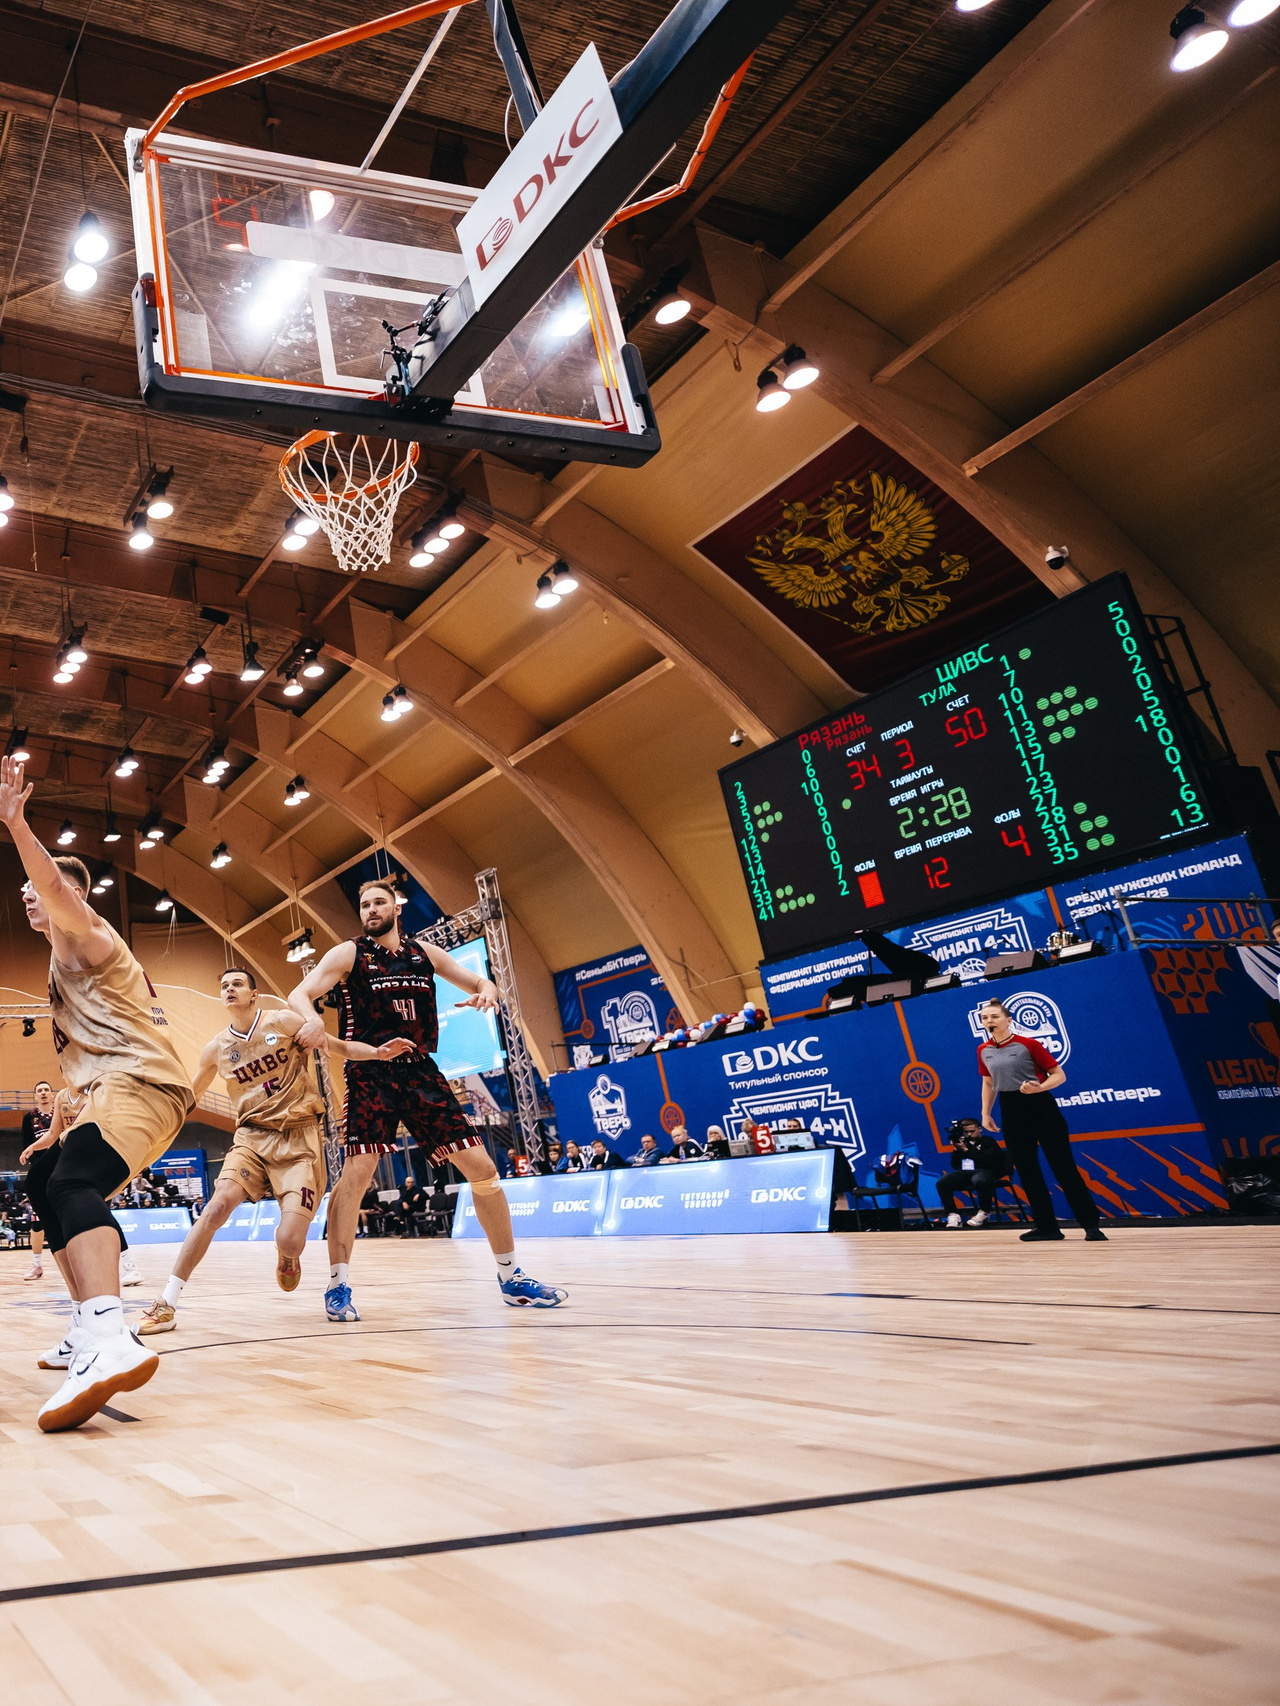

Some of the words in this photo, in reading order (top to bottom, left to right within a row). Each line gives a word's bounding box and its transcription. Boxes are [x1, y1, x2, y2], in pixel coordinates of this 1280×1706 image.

[513, 97, 600, 224] DKC
[1000, 655, 1010, 671] 1
[1107, 600, 1124, 621] 5
[1003, 669, 1015, 688] 7
[1115, 619, 1130, 637] 0
[936, 643, 993, 683] ЦИВС
[998, 687, 1024, 710] 10
[1122, 636, 1138, 655] 0
[919, 682, 957, 706] ТУЛА
[946, 694, 970, 712] СЧЕТ
[1004, 704, 1028, 726] 11
[1128, 654, 1146, 674] 2
[1010, 720, 1037, 743] 13
[1135, 672, 1152, 690] 0
[881, 720, 914, 742] ПЕРИОД
[945, 707, 988, 748] 50
[1016, 736, 1042, 759] 15
[1142, 689, 1160, 710] 5
[1021, 753, 1045, 776] 17
[1135, 708, 1167, 733] 18
[846, 742, 867, 757] СЧЕТ
[895, 738, 915, 770] 3
[1026, 771, 1055, 795] 23
[1157, 727, 1174, 746] 0
[734, 781, 744, 797] 2
[802, 750, 811, 764] 0
[739, 797, 748, 810] 3
[806, 763, 816, 778] 6
[847, 754, 882, 790] 34
[1032, 787, 1057, 812] 27
[1165, 746, 1181, 765] 0
[741, 808, 751, 822] 5
[801, 778, 819, 796] 10
[889, 789, 917, 806] ВРЕМЯ
[920, 778, 945, 795] ИГРЫ
[1037, 806, 1067, 830] 28
[1172, 765, 1186, 783] 1
[741, 835, 757, 852] 12
[818, 806, 828, 821] 9
[745, 822, 754, 836] 9
[813, 792, 824, 807] 0
[896, 786, 971, 839] 2:28
[1043, 823, 1071, 847] 31
[1180, 783, 1197, 803] 6
[744, 848, 762, 867] 13
[822, 820, 832, 836] 0
[894, 843, 922, 860] ВРЕМЯ
[925, 826, 973, 849] ПЕРЕРЫВА
[1001, 824, 1031, 857] 4
[1049, 841, 1079, 865] 35
[1170, 802, 1204, 827] 13
[748, 862, 766, 880] 14
[826, 835, 836, 850] 0
[751, 877, 768, 895] 21
[830, 849, 841, 865] 0
[924, 856, 951, 889] 12
[755, 890, 773, 908] 33
[833, 864, 843, 880] 7
[1065, 888, 1108, 908] СРЕДИ
[1108, 870, 1178, 897] МУЖСКИХ
[1178, 854, 1243, 879] КОМАНД
[759, 903, 775, 921] 41
[838, 880, 850, 896] 2
[928, 937, 982, 963] ИНАЛ
[929, 924, 974, 942] ЧЕМПИОНАТ
[974, 920, 993, 932] ЦФО
[575, 952, 647, 982] #СемьяБКТверь
[767, 966, 813, 984] ЧЕМПИОНАТ
[769, 972, 832, 994] ФЕДЕРАЛЬНОГО
[832, 964, 865, 980] ОКРУГА
[371, 980, 432, 996] РЯЗАНЬ
[392, 999, 416, 1021] 41
[232, 1047, 289, 1085] ЦИВС
[753, 1036, 824, 1071] DKC
[729, 1073, 782, 1090] Титульный
[783, 1066, 829, 1081] спонсор
[593, 1113, 632, 1134] ТВЕРЬ
[749, 1101, 797, 1116] ЧЕМПИОНАТ
[798, 1098, 820, 1111] ЦФО
[756, 1130, 771, 1148] 5
[518, 1158, 528, 1174] 5
[300, 1186, 315, 1212] 15
[564, 1199, 591, 1213] DKC
[634, 1195, 665, 1209] DKC
[769, 1186, 807, 1202] DKC
